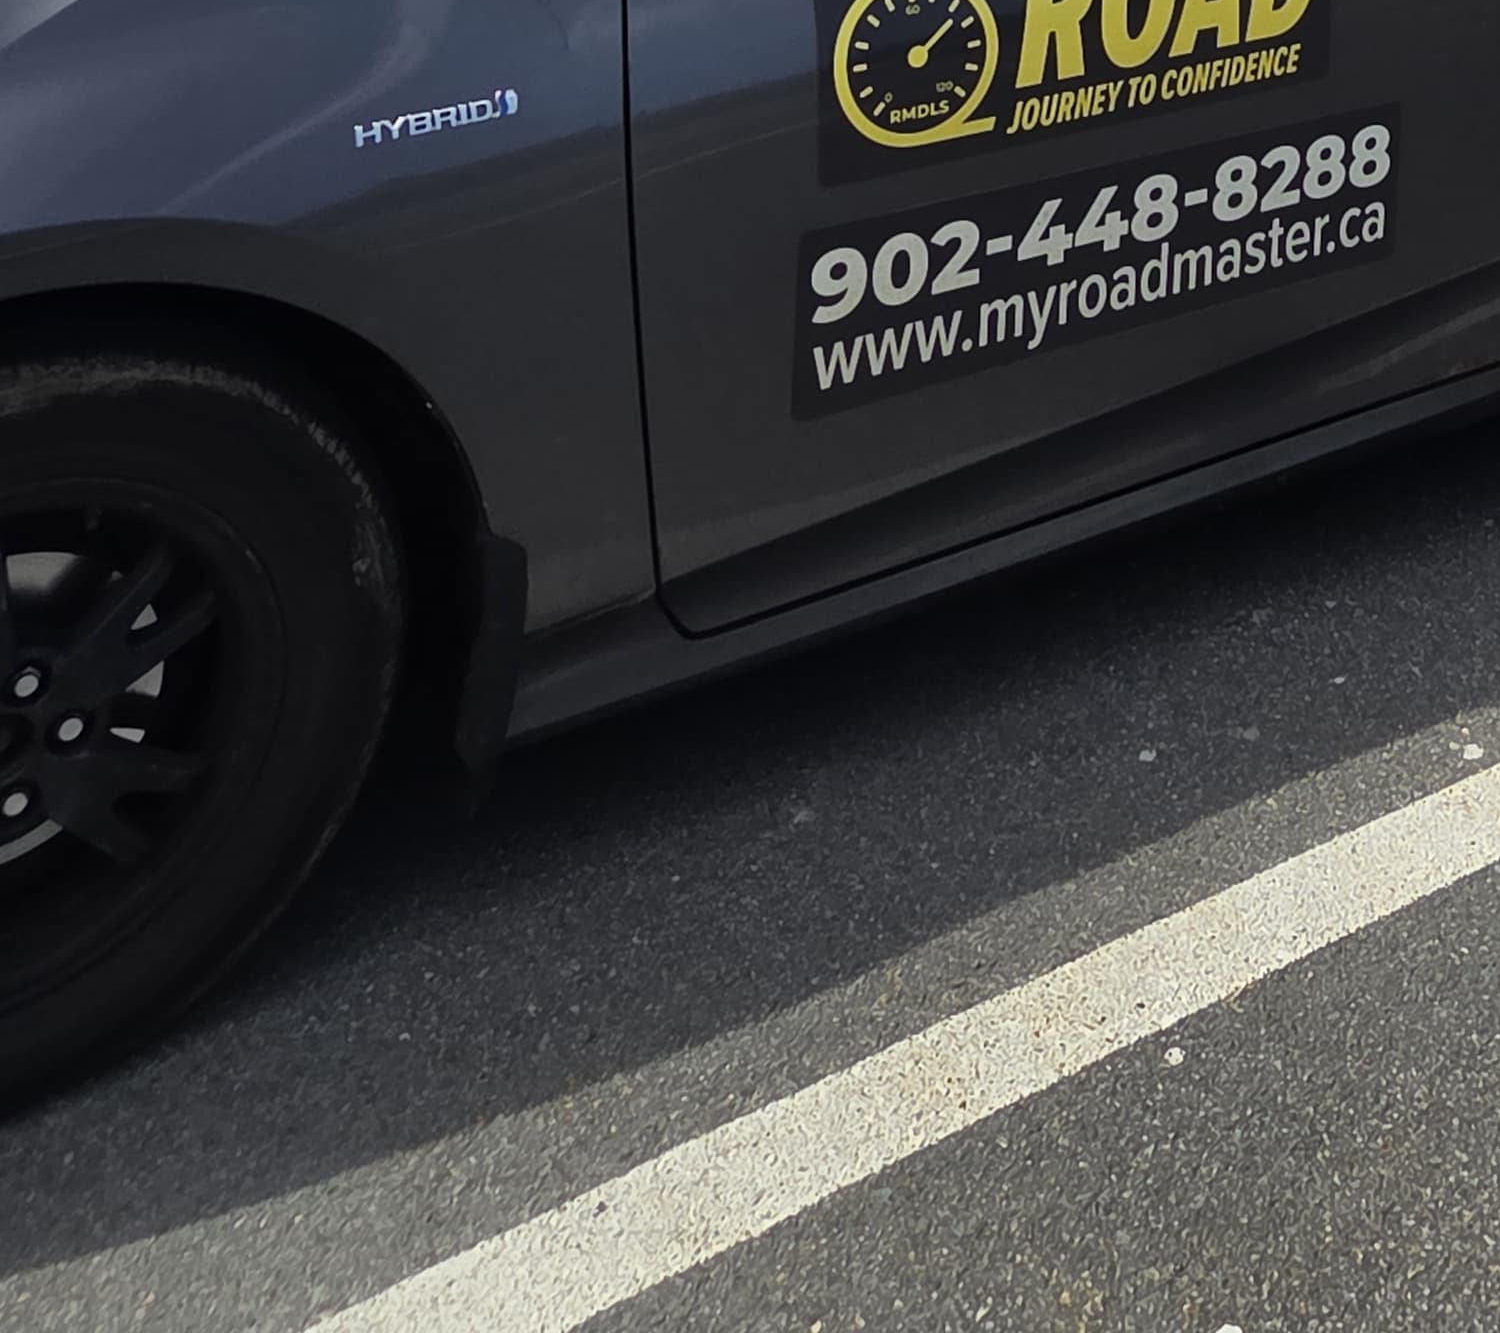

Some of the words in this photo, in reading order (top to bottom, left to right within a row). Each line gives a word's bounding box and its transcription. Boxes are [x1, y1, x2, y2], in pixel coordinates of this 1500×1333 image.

[905, 4, 921, 16] 60
[884, 92, 893, 103] 0
[889, 99, 950, 124] RMDLS
[1006, 80, 1124, 134] JOURNEY
[1127, 72, 1157, 108] TO
[1160, 43, 1302, 101] CONFIDENCE
[353, 99, 494, 148] HYBRID
[810, 124, 1393, 324] 902-448-8288
[811, 200, 1387, 392] www.myroadmaster.ca
